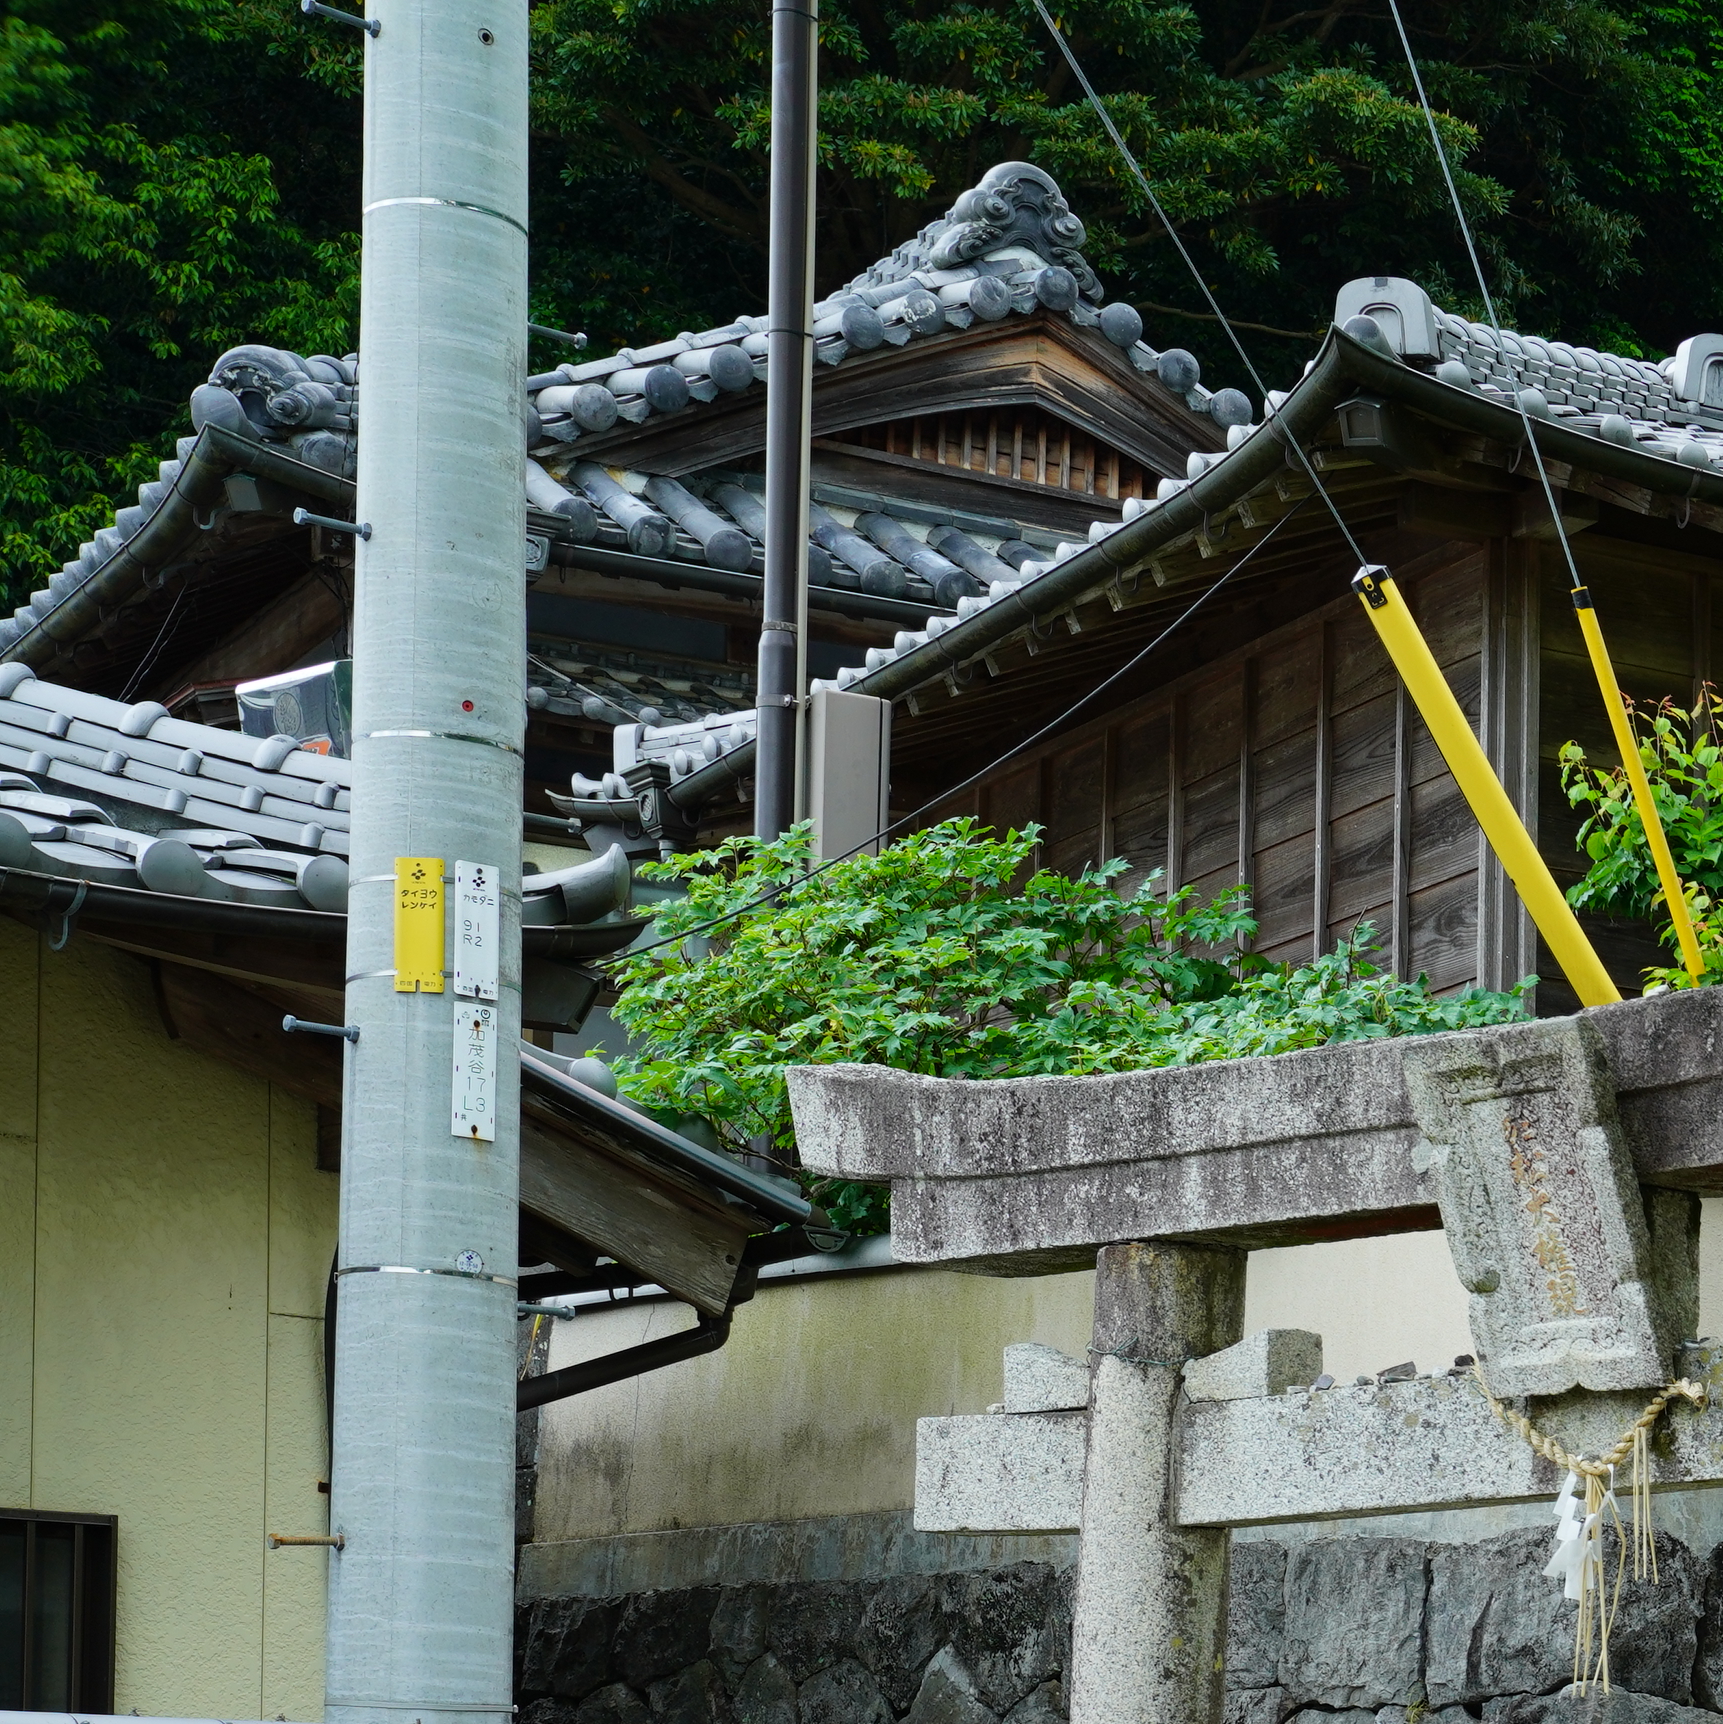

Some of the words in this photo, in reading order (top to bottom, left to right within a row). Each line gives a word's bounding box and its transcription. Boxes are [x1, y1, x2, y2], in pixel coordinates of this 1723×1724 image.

[401, 889, 438, 900] タイヨウ
[463, 893, 495, 907] カモダニ
[401, 901, 437, 910] レンケイ
[463, 919, 482, 933] 91
[463, 933, 483, 948] R2
[468, 1028, 486, 1075] 加茂谷
[467, 1075, 487, 1092] 17
[463, 1095, 486, 1113] L3
